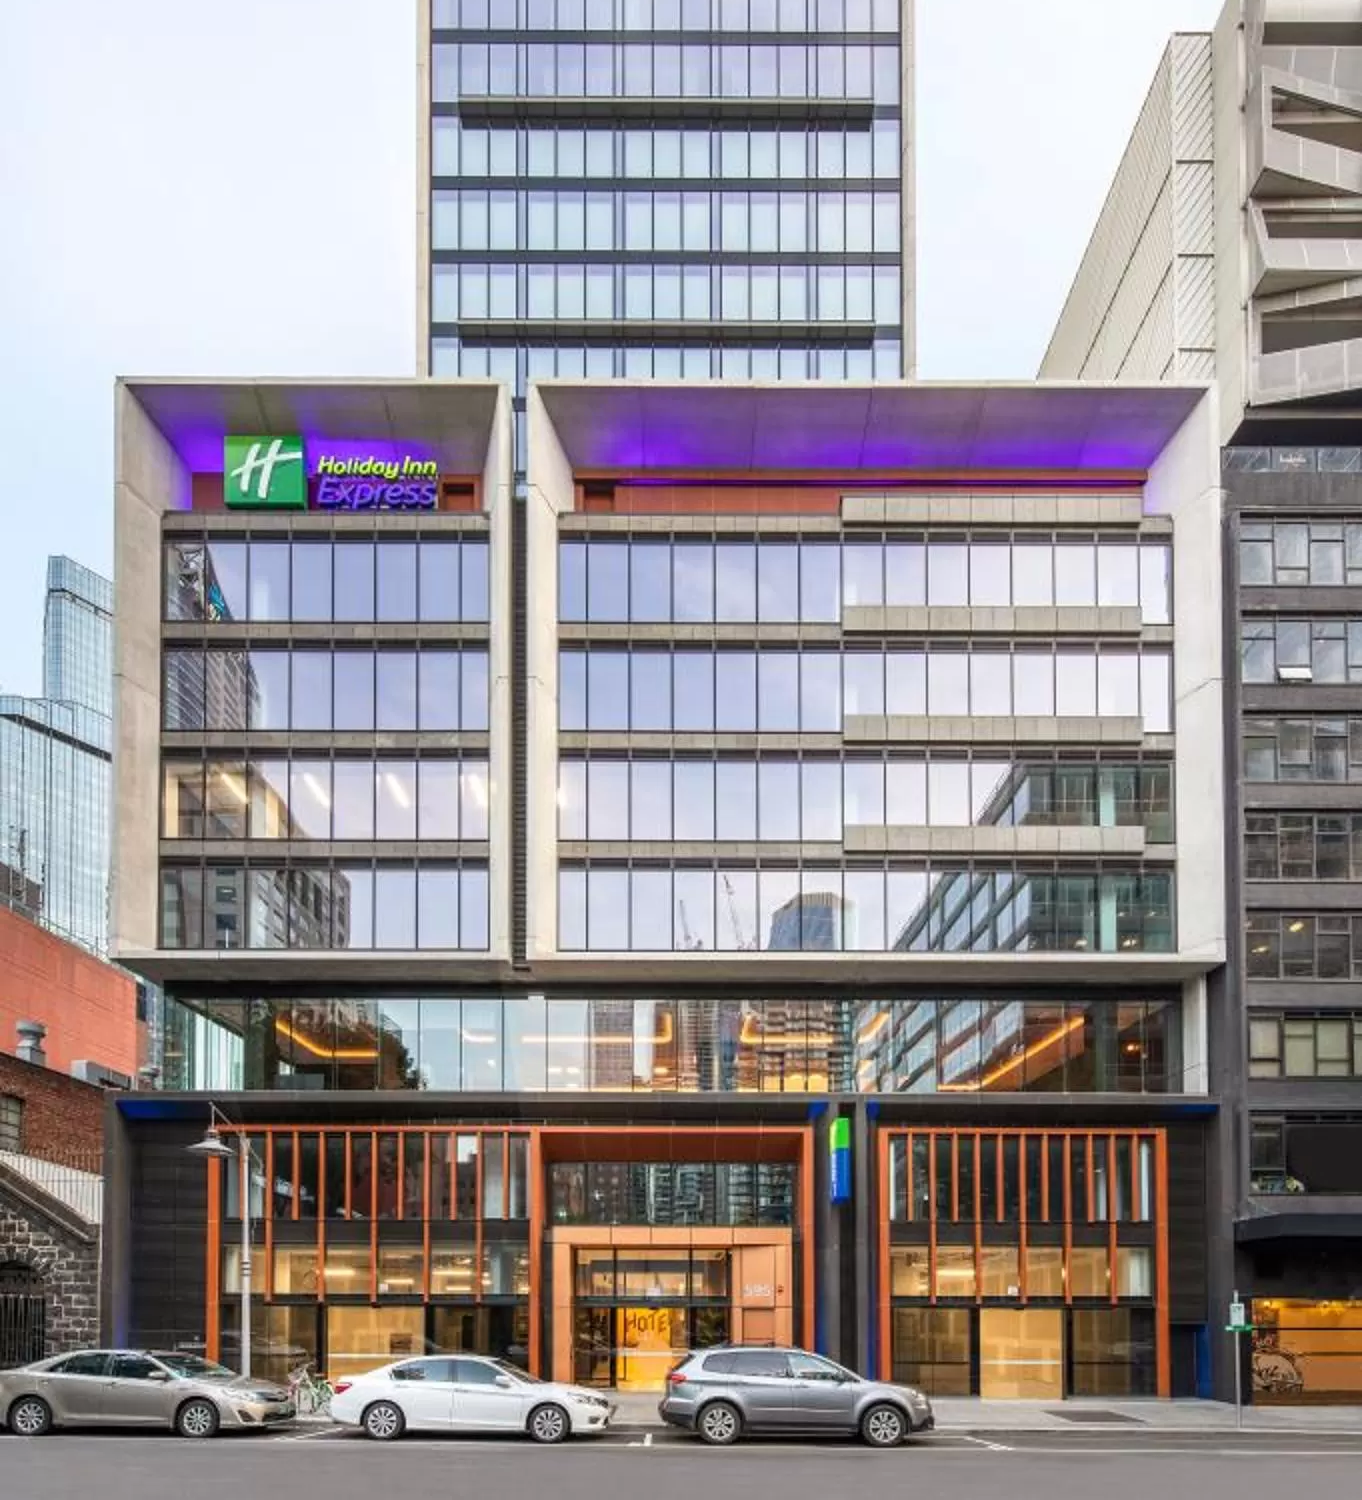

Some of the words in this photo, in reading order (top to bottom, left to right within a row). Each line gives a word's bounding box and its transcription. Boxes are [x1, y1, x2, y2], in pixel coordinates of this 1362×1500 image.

[318, 455, 400, 479] Holiday
[402, 455, 437, 475] Inn
[317, 476, 437, 509] Express
